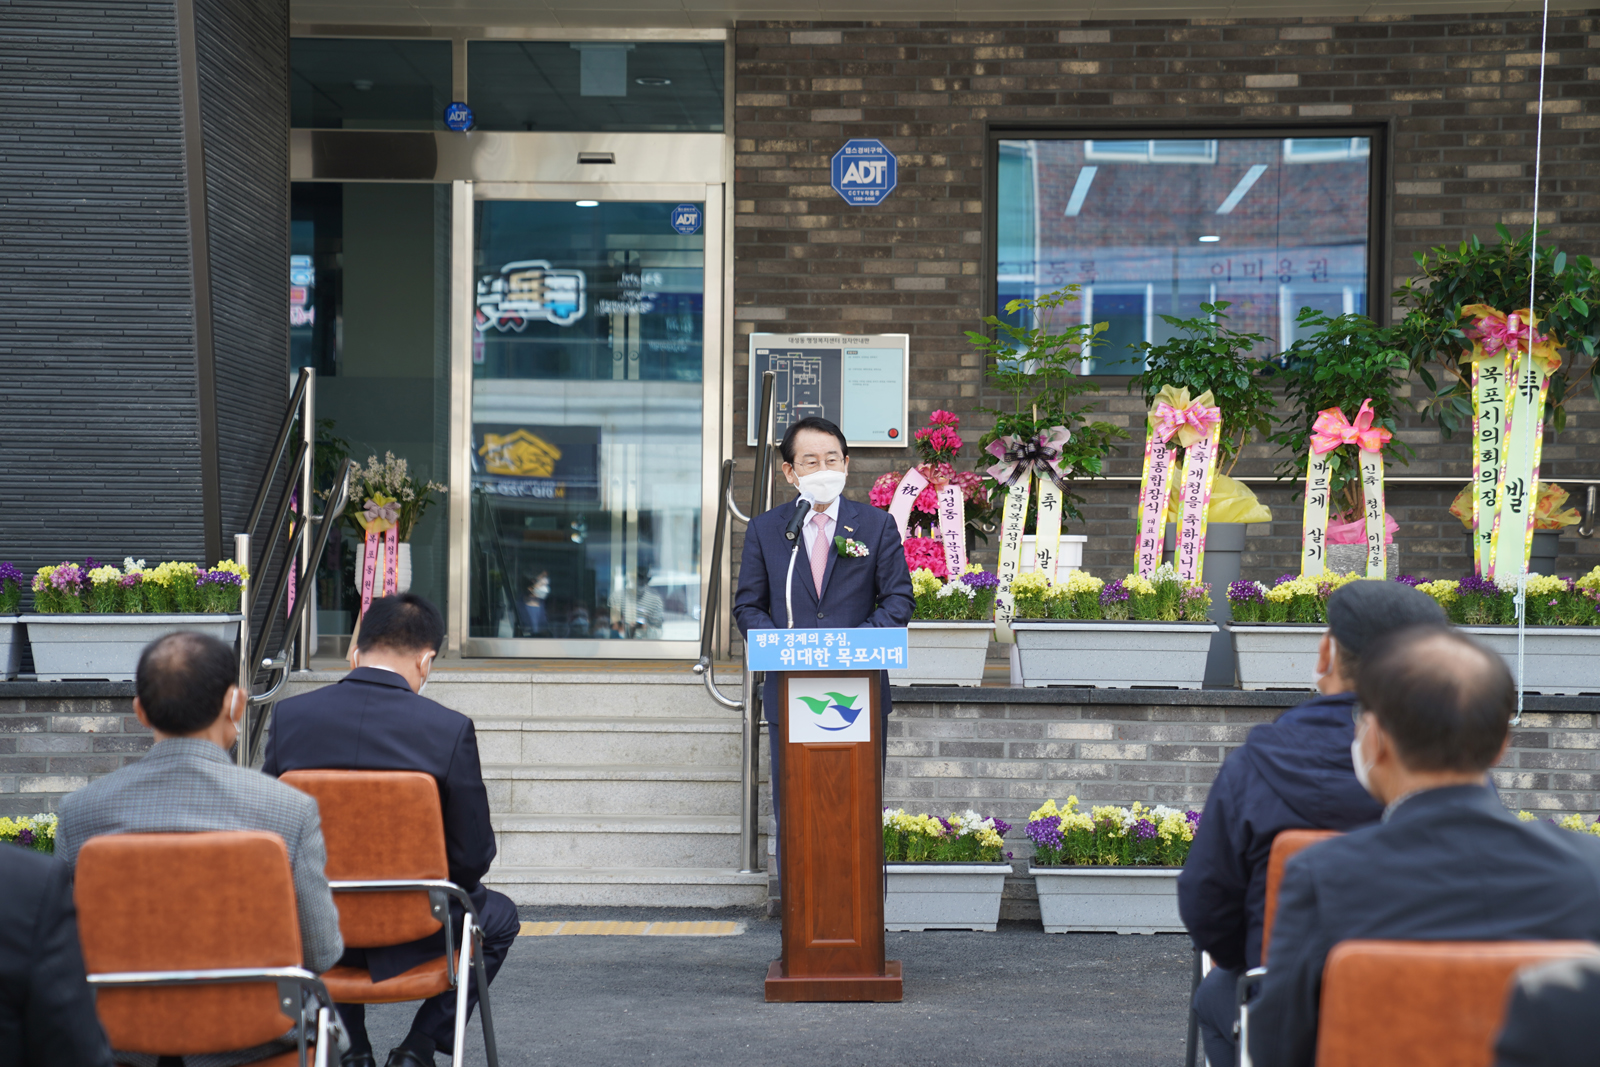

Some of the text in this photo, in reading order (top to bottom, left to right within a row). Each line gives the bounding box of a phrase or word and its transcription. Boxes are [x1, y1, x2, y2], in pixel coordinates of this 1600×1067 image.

[448, 111, 468, 122] ADT
[841, 160, 887, 184] ADT
[675, 213, 697, 226] ADT
[1479, 366, 1503, 508] 목포시의회의장
[1505, 370, 1541, 514] 축 발
[1361, 463, 1377, 486] 신축
[901, 483, 919, 497] 祝
[1185, 468, 1204, 508] 개청을
[1306, 458, 1330, 560] 바르게 살기
[1036, 492, 1057, 570] 축 발
[1146, 518, 1156, 534] 대표
[1180, 513, 1199, 581] 축하합니다
[1368, 533, 1383, 567] 이전을
[755, 632, 851, 648] 평화 경제의 중심,
[779, 646, 903, 667] 위대한 목포시대
